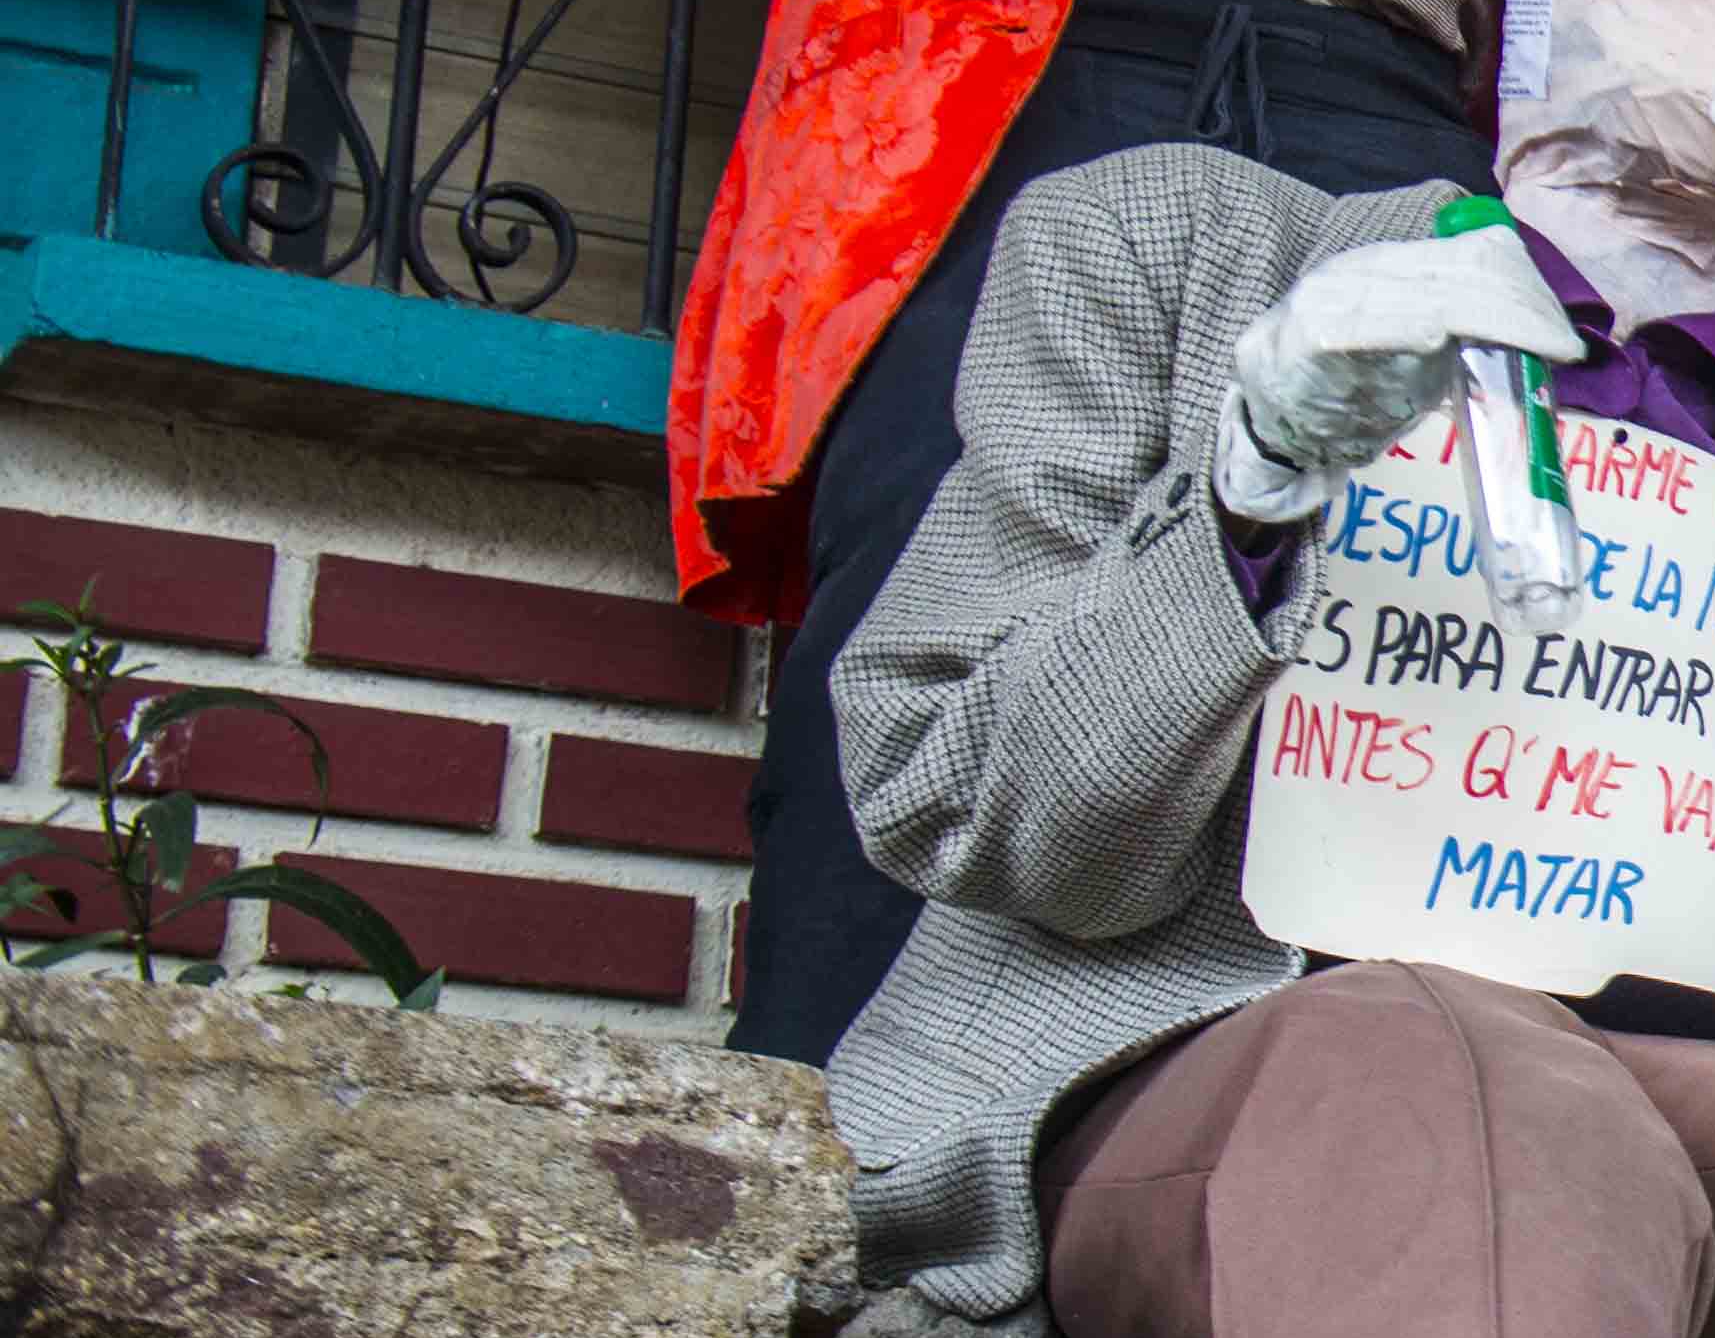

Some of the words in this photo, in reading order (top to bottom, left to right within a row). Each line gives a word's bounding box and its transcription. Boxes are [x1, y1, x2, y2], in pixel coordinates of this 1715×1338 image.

[1632, 545, 1681, 620] LA
[1364, 604, 1503, 694] PARA
[1522, 633, 1714, 739] ENTRAR
[1272, 692, 1436, 791] ANTES
[1462, 724, 1540, 801] Q'
[1535, 746, 1637, 824] ME
[1424, 835, 1646, 927] MATAR
